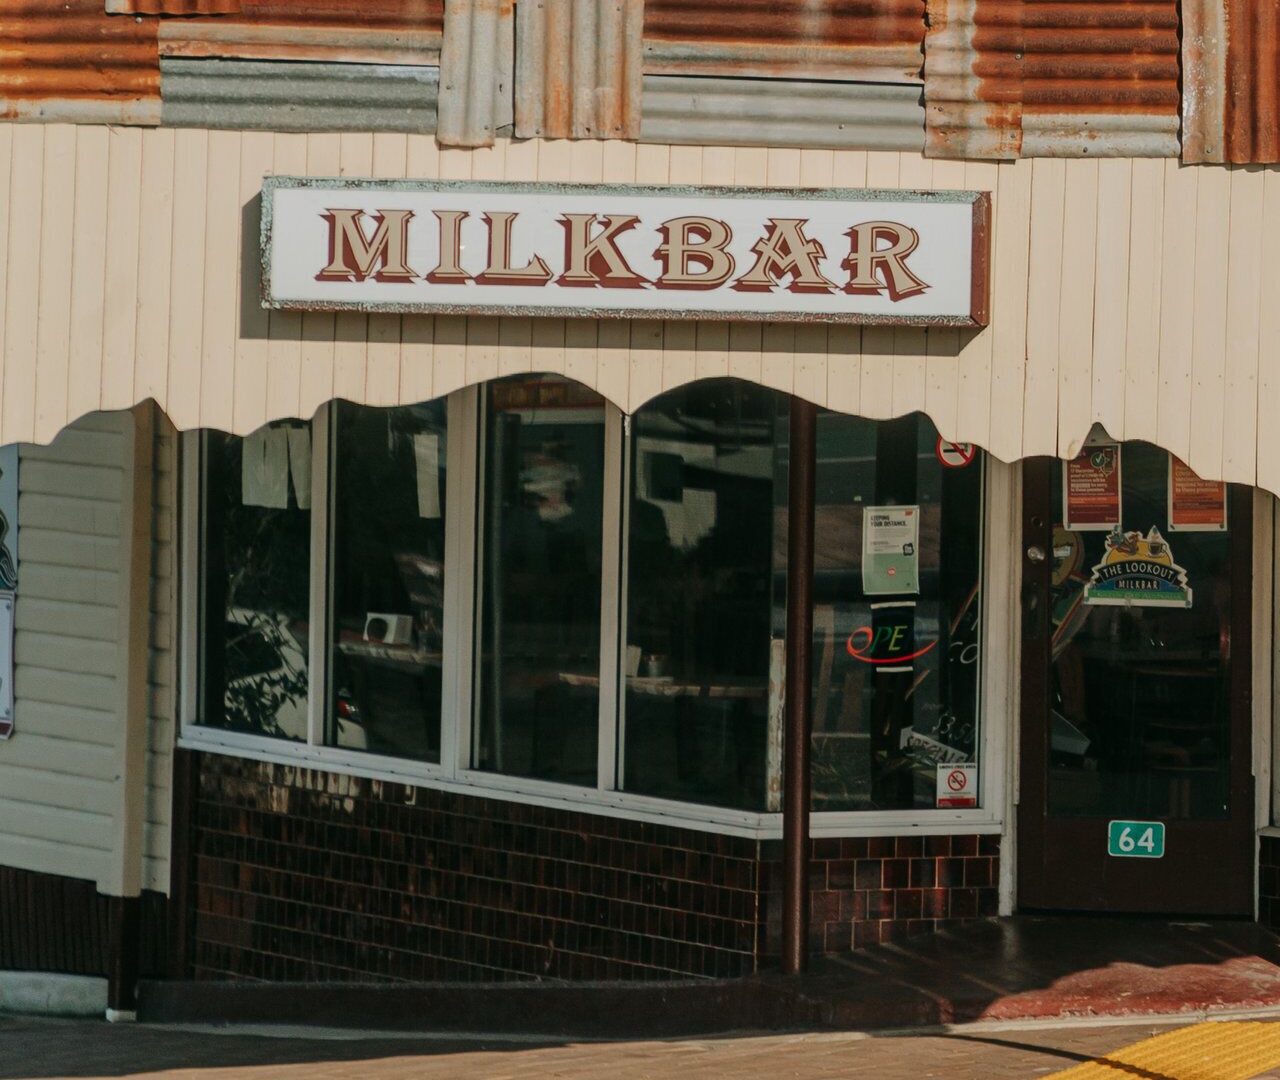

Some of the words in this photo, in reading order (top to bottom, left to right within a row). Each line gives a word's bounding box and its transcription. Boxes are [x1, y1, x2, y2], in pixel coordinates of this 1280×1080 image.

[313, 206, 934, 303] MILKBAR
[1103, 565, 1122, 579] THE
[1125, 562, 1175, 580] LOOKOUT
[1118, 580, 1158, 590] MILKBAR
[1119, 826, 1155, 853] 64
